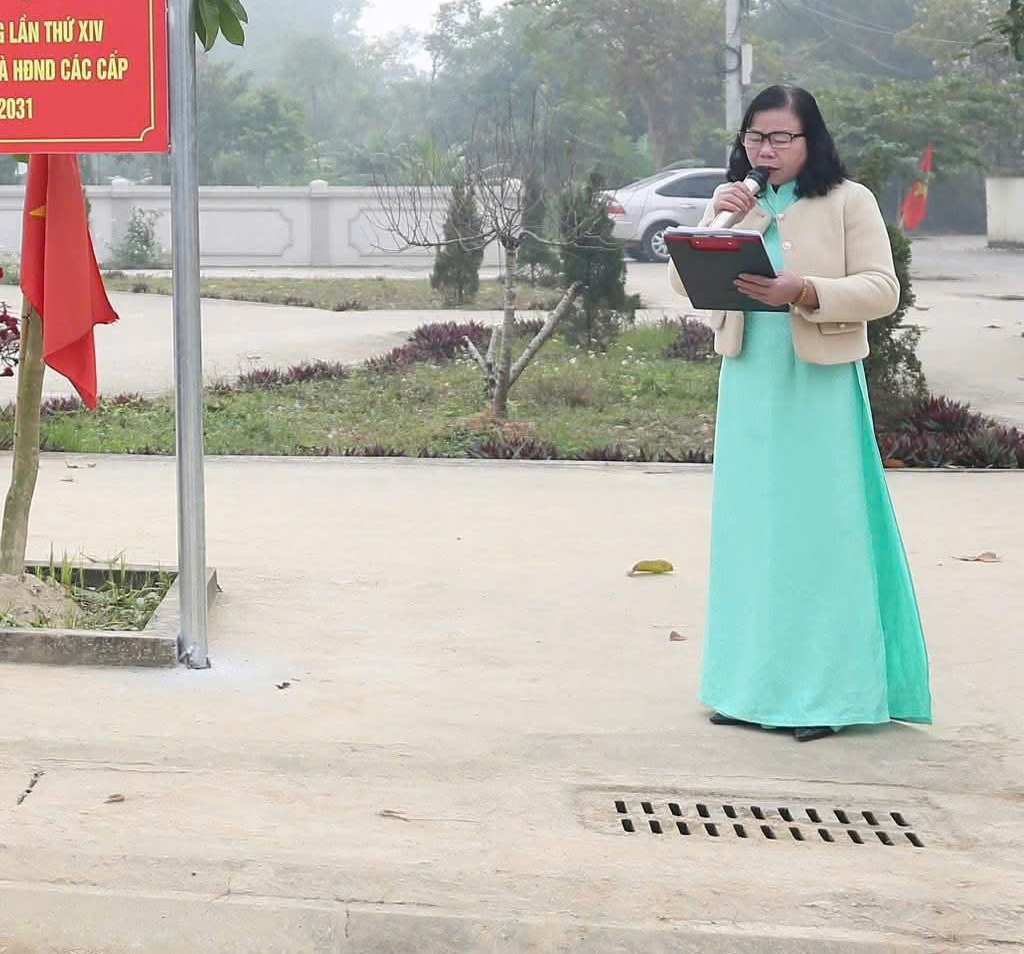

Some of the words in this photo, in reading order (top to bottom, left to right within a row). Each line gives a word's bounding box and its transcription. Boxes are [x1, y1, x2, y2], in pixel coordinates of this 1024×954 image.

[8, 13, 40, 44] LẦN
[43, 15, 76, 43] THỨ
[77, 19, 104, 43] XIV
[12, 58, 56, 82] HĐND
[60, 53, 92, 81] CÁC
[96, 49, 129, 81] CẤP
